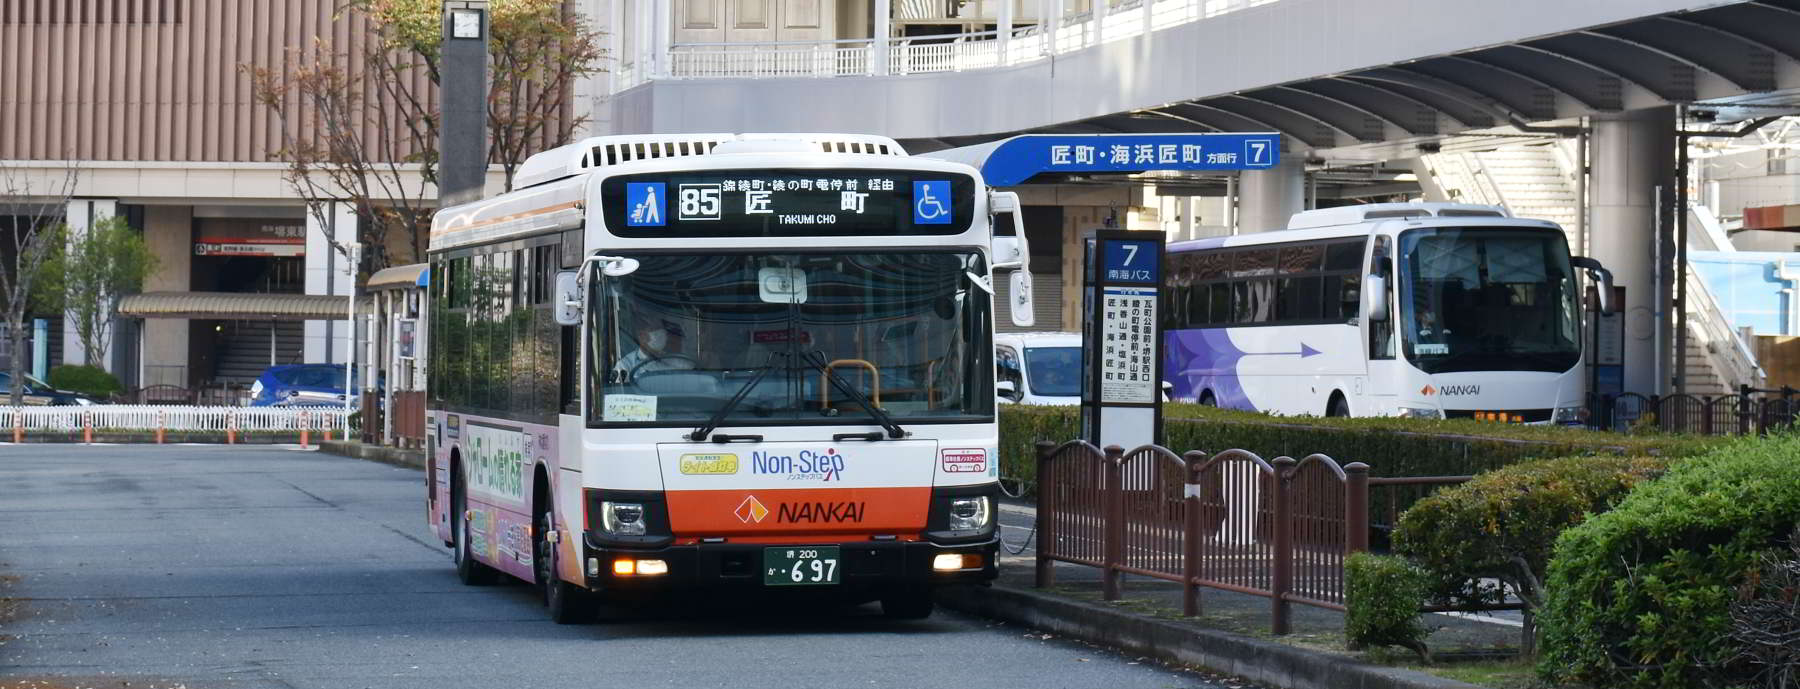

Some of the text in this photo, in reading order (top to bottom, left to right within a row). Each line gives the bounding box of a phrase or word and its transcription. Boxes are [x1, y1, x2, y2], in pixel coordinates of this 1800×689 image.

[1051, 144, 1237, 165] 匠町・海浜匠町 方面行
[1251, 144, 1265, 163] 7
[868, 178, 894, 191] 経由
[681, 188, 720, 215] 85
[778, 215, 836, 225] TAKUMI CHO
[1122, 244, 1138, 266] 7
[1108, 269, 1151, 280] 南海バス
[1440, 385, 1480, 396] NANKAI
[752, 449, 844, 481] Non-Step
[777, 502, 865, 523] NANKAI
[798, 550, 818, 559] 200
